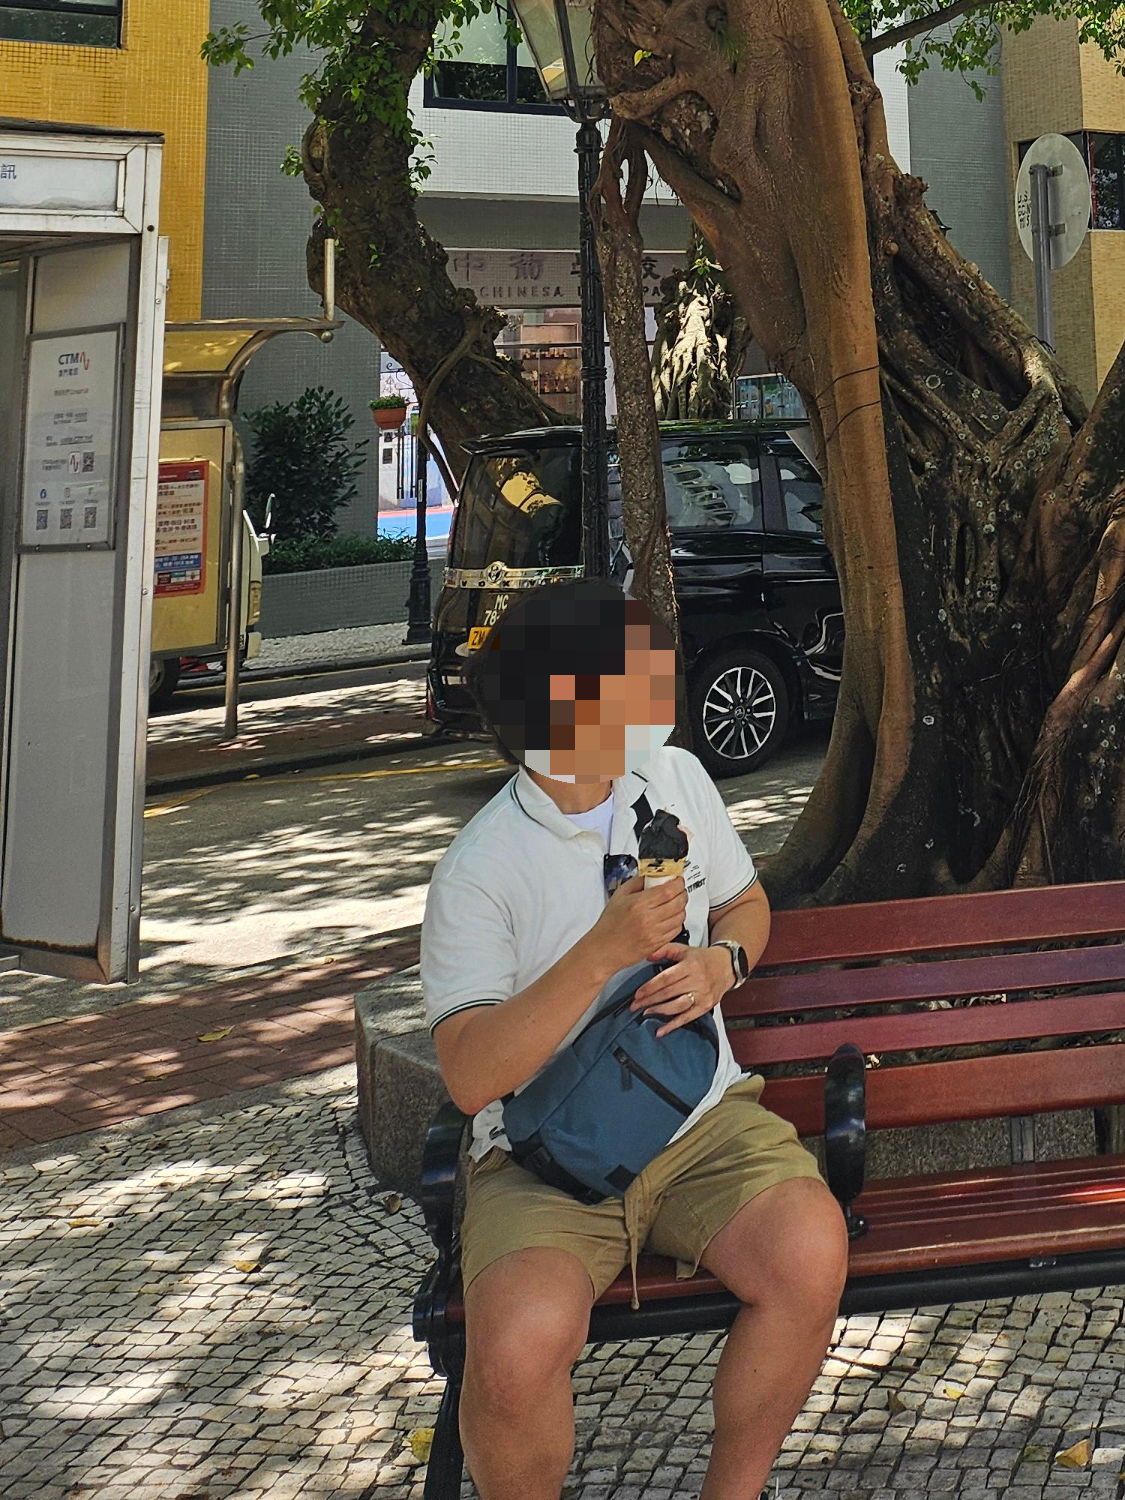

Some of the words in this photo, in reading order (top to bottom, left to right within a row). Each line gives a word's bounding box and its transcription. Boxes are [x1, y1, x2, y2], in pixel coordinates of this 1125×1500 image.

[58, 352, 80, 366] CTM
[494, 594, 509, 611] MC
[483, 610, 501, 626] 78-
